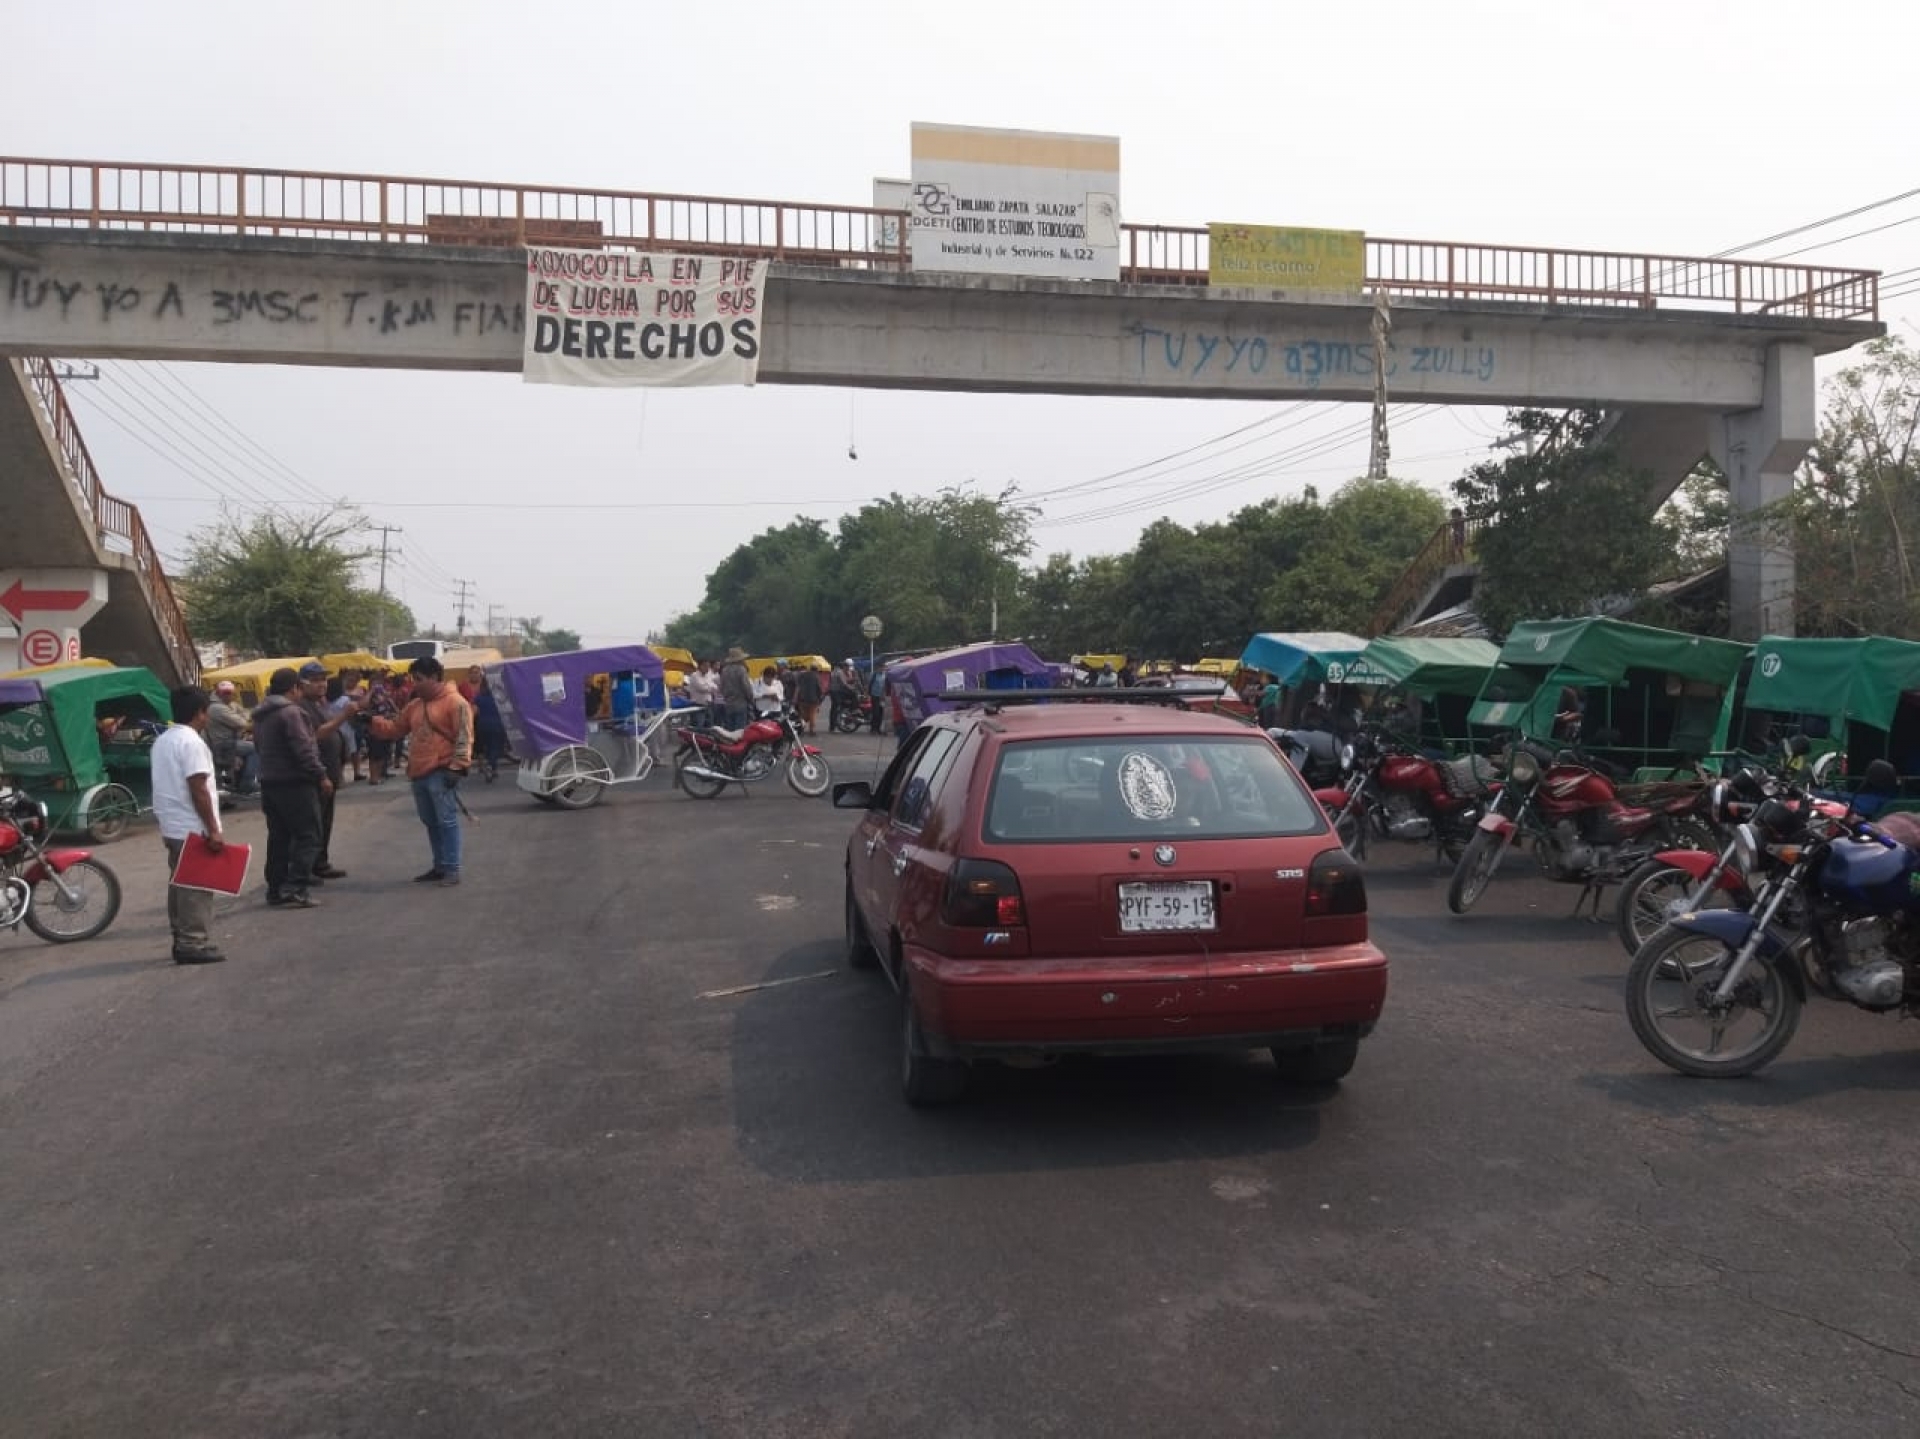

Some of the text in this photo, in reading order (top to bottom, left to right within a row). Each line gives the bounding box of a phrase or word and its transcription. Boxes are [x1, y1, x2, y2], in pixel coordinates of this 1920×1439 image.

[998, 199, 1029, 215] ZAPATA
[913, 216, 950, 229] DGETI
[951, 217, 985, 234] CENTRO
[987, 218, 997, 235] DE
[999, 219, 1034, 237] ESTUDIOS
[985, 246, 992, 259] y
[995, 246, 1007, 256] de
[1010, 245, 1054, 258] Servicios
[528, 249, 757, 285] XOXOCOTLA EN PIE
[154, 281, 184, 319] A
[533, 281, 757, 318] DE LUCHA POR SUS
[533, 315, 758, 360] DERECHOS
[33, 638, 52, 658] E
